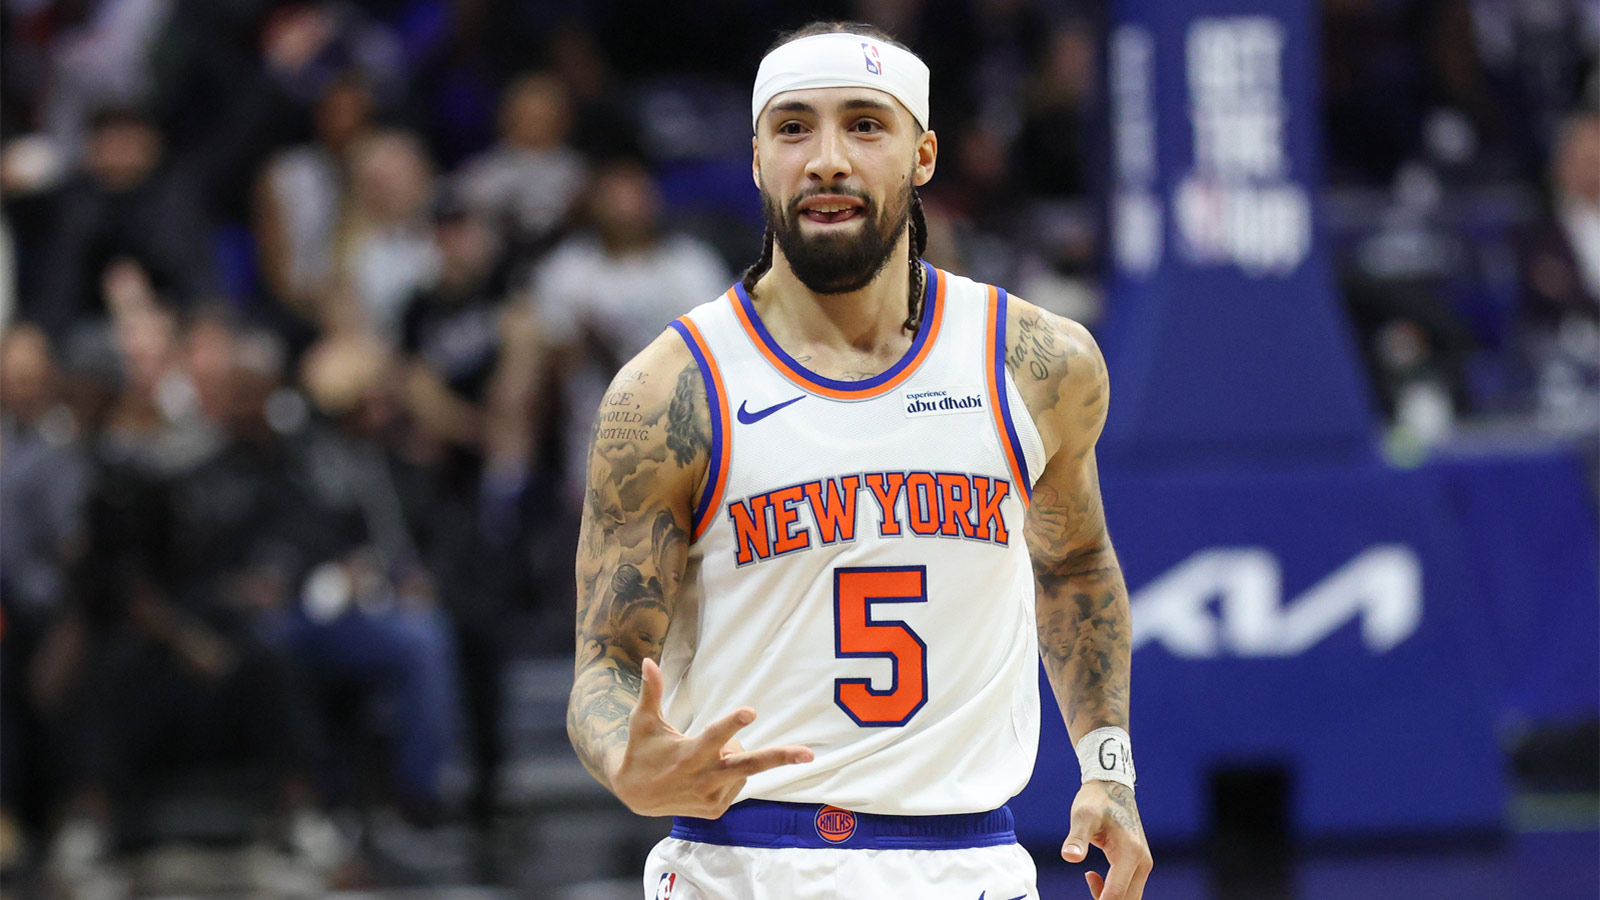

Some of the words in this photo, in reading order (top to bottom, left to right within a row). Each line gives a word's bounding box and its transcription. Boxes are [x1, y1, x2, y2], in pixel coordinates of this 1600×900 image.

[906, 390, 948, 400] experience
[907, 399, 937, 414] abu
[727, 474, 863, 568] NEW
[863, 469, 1011, 549] YORK
[833, 565, 929, 728] 5
[820, 813, 852, 832] KNICKS
